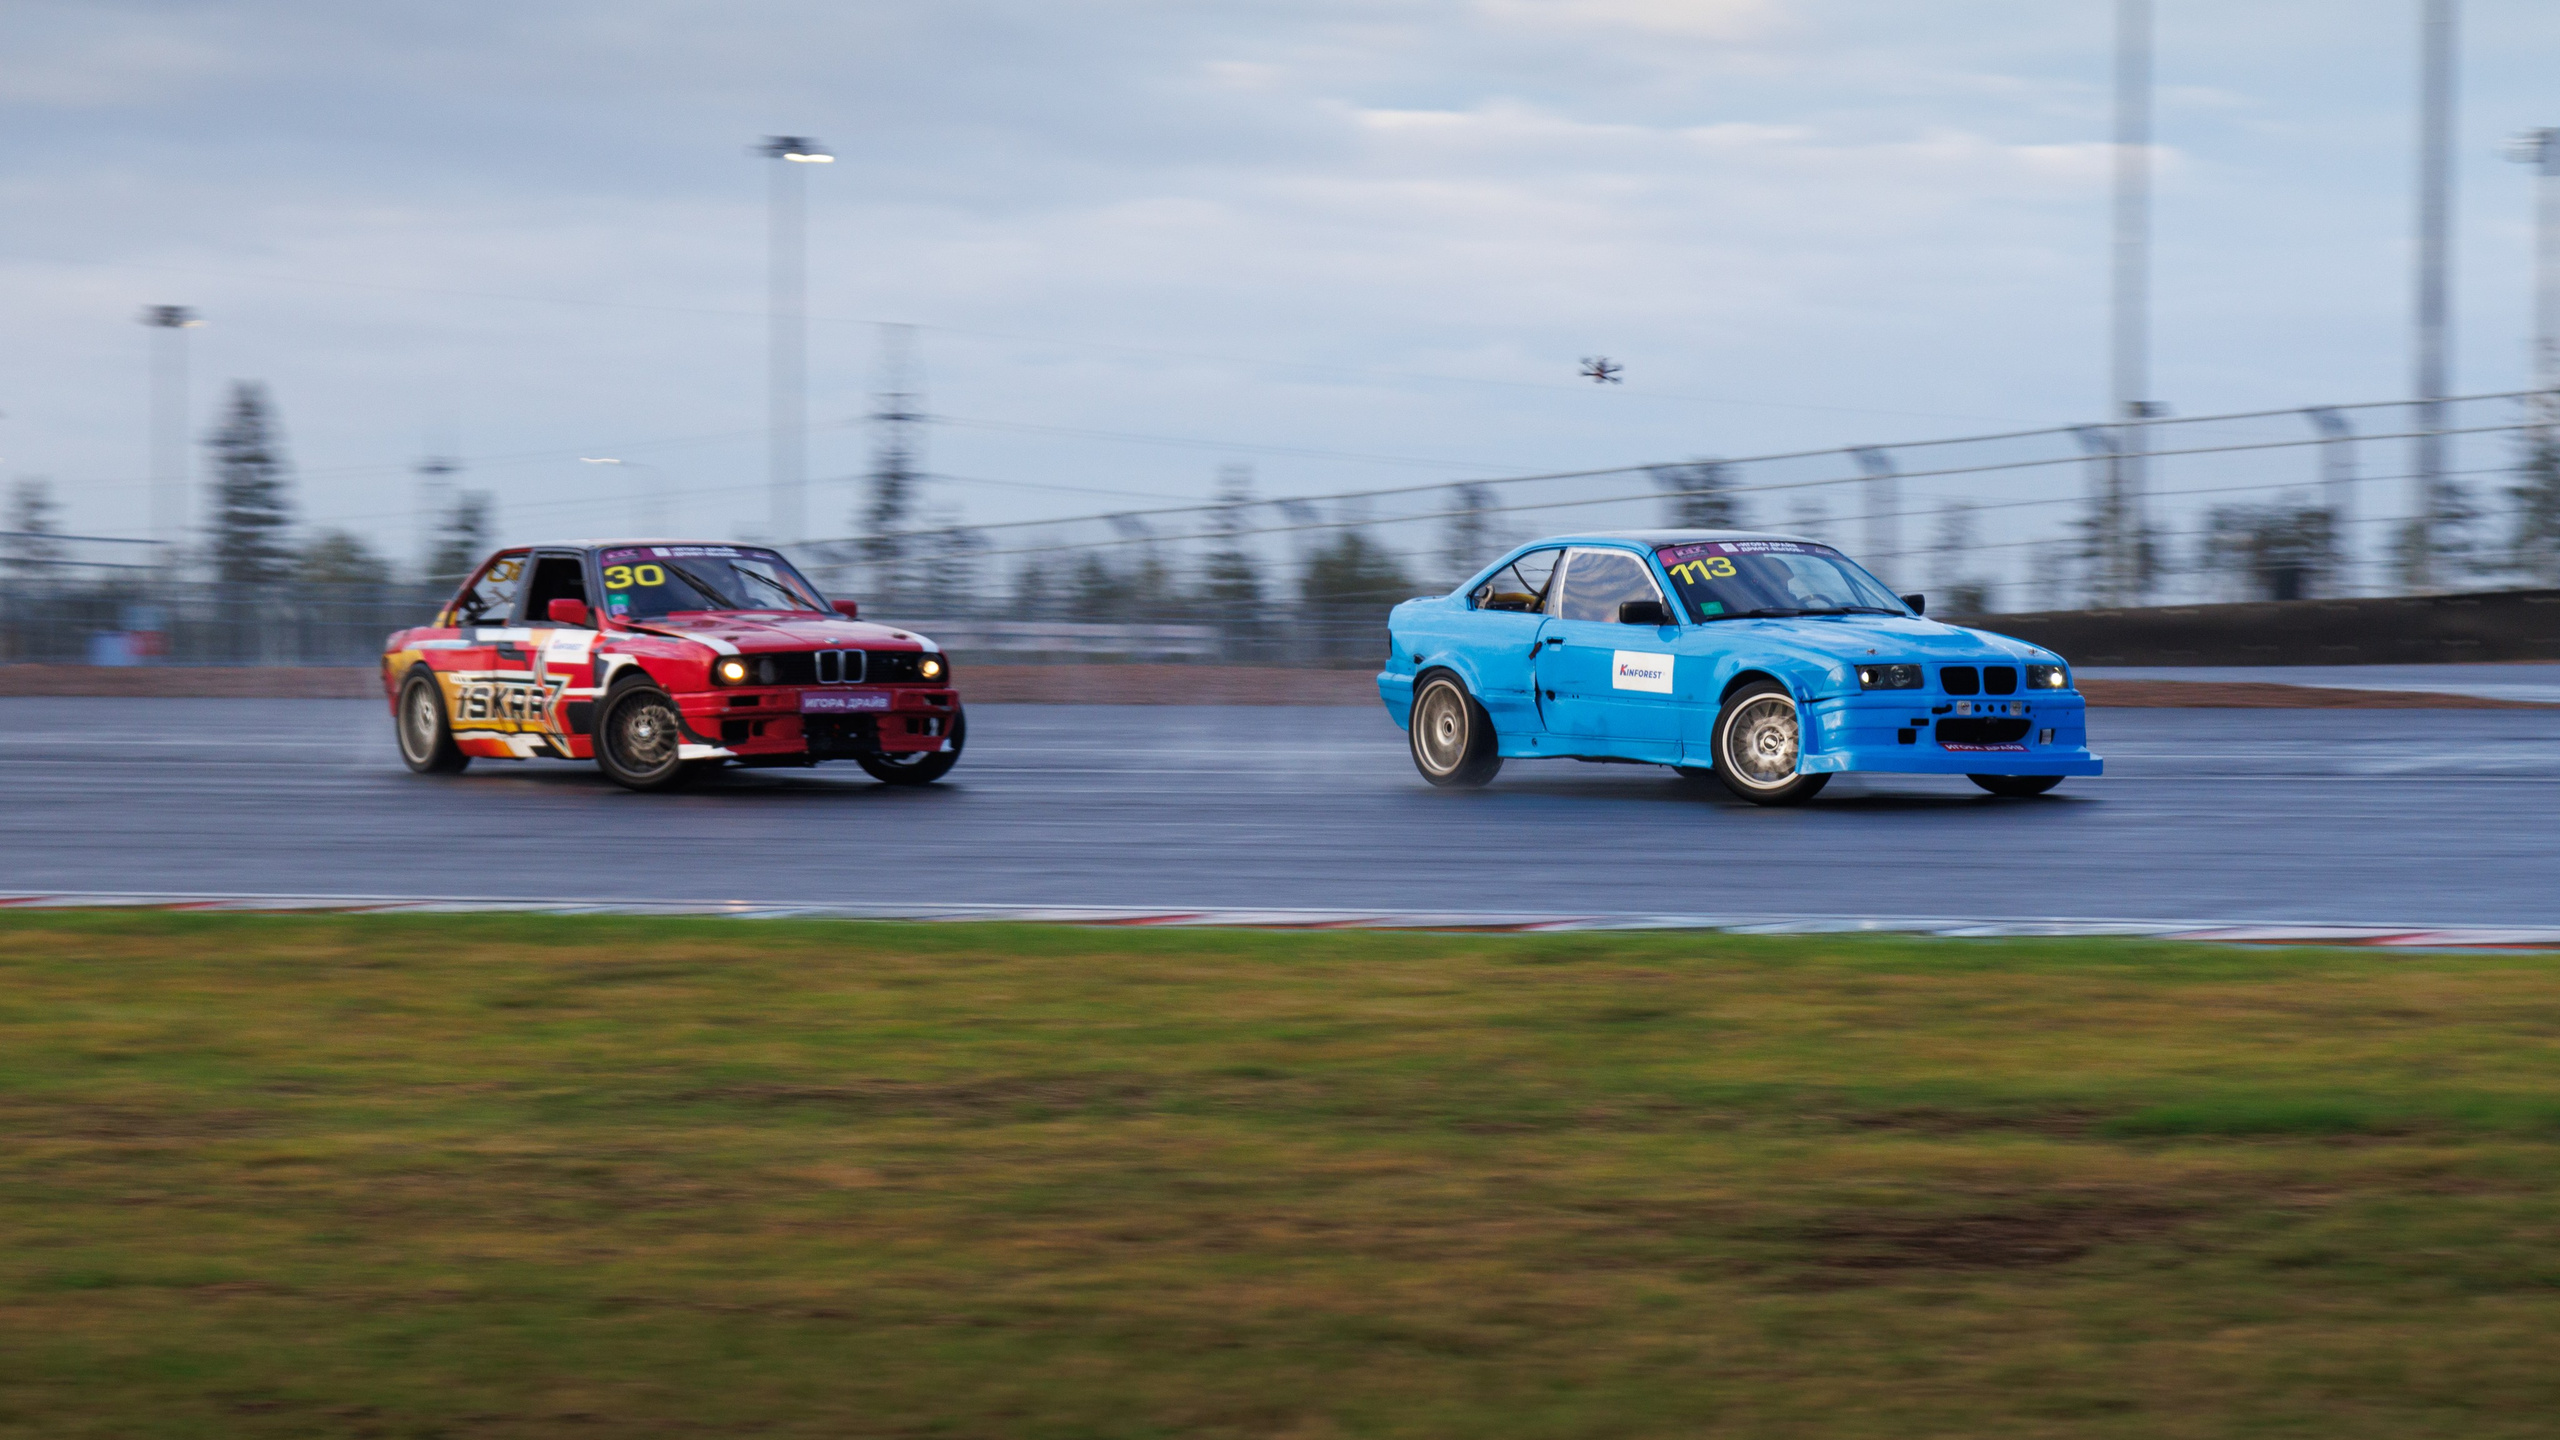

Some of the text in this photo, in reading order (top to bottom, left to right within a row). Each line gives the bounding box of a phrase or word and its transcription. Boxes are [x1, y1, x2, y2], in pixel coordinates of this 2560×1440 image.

[604, 564, 666, 590] 30
[1669, 556, 1737, 585] 113
[1619, 663, 1663, 679] KINFOREST
[804, 696, 889, 709] ИГОРА ДРАЙВ
